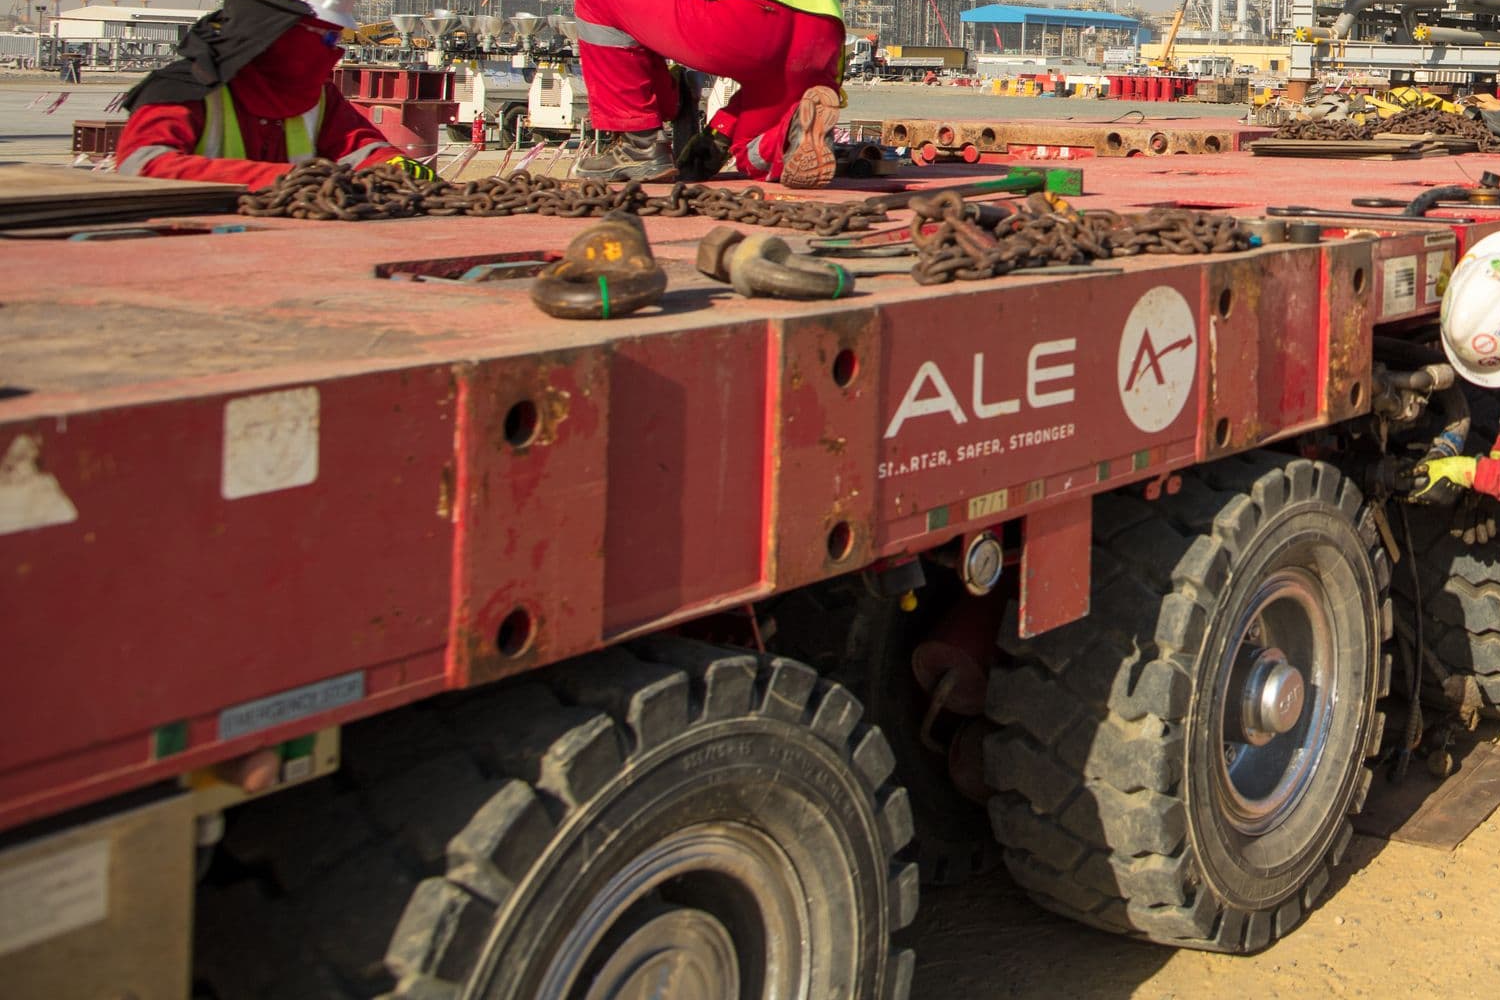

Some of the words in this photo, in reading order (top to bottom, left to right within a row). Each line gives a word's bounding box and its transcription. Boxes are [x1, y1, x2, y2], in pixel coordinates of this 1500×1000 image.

[884, 338, 1076, 439] ALE
[957, 439, 1005, 461] SAFER,
[1009, 423, 1076, 450] STRONGER
[972, 491, 1006, 517] 17/1
